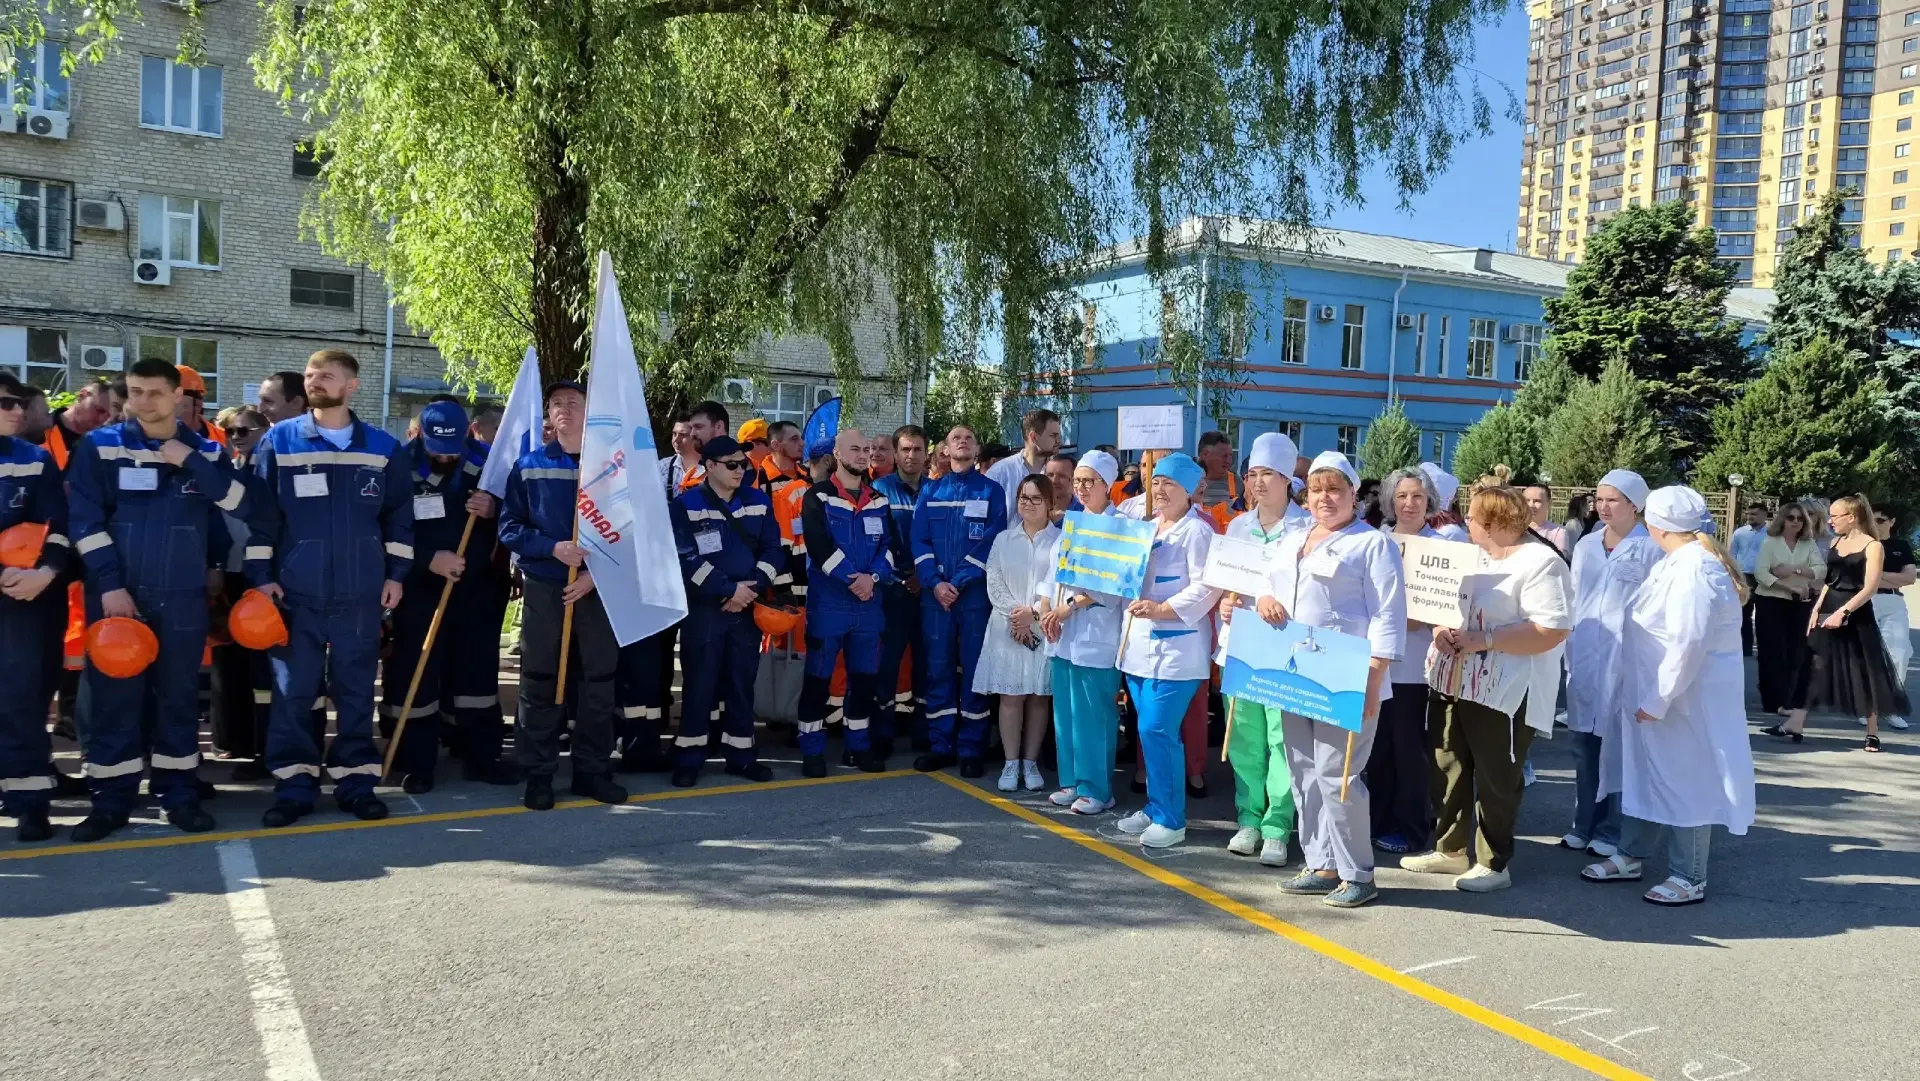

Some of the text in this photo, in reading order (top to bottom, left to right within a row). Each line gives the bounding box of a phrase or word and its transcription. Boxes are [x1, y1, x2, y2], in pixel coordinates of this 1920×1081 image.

[1420, 554, 1450, 569] ЦЛВ
[1415, 570, 1459, 585] Точность
[1404, 583, 1468, 600] наша главная
[1412, 595, 1456, 611] формула
